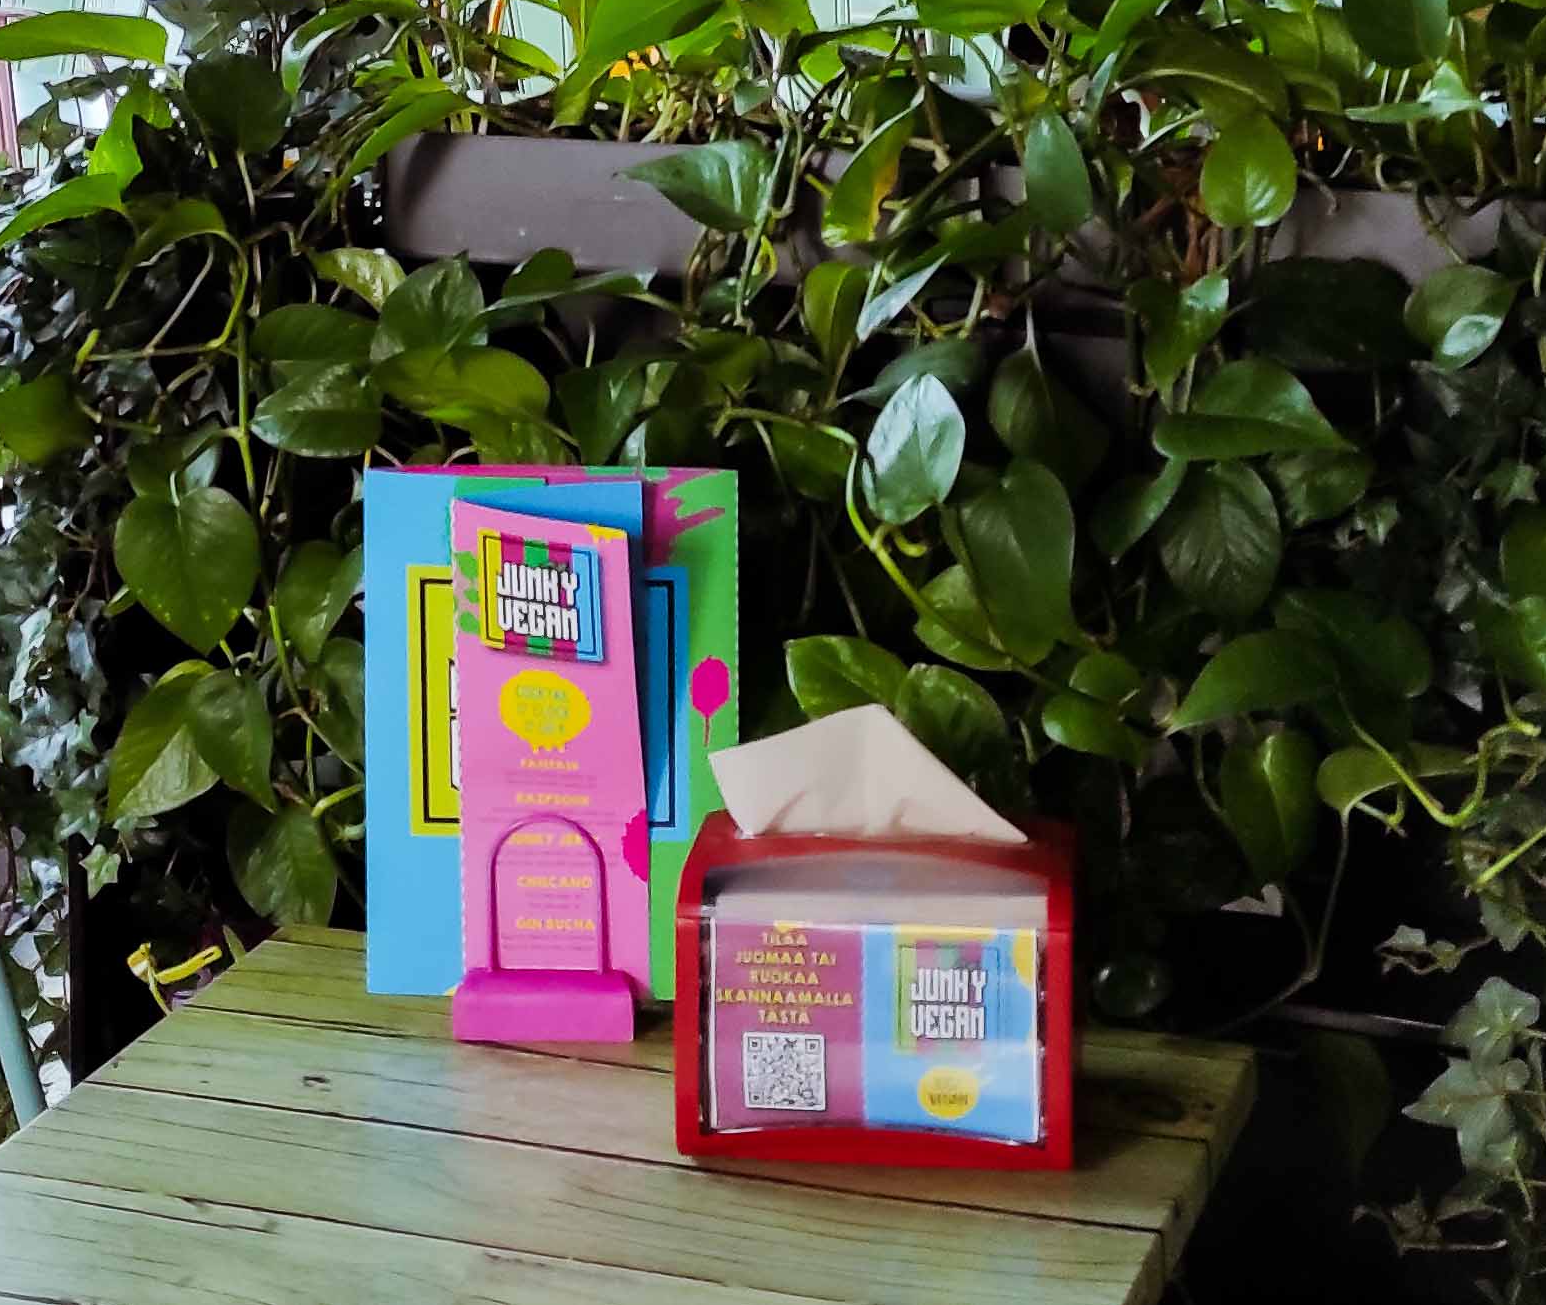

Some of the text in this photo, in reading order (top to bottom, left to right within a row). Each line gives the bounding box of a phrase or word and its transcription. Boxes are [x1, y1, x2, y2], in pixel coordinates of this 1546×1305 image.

[497, 562, 577, 606] JUNKY
[497, 596, 578, 641] VEGAN
[910, 967, 987, 1003] JUNKY
[910, 1004, 986, 1040] VEGAN
